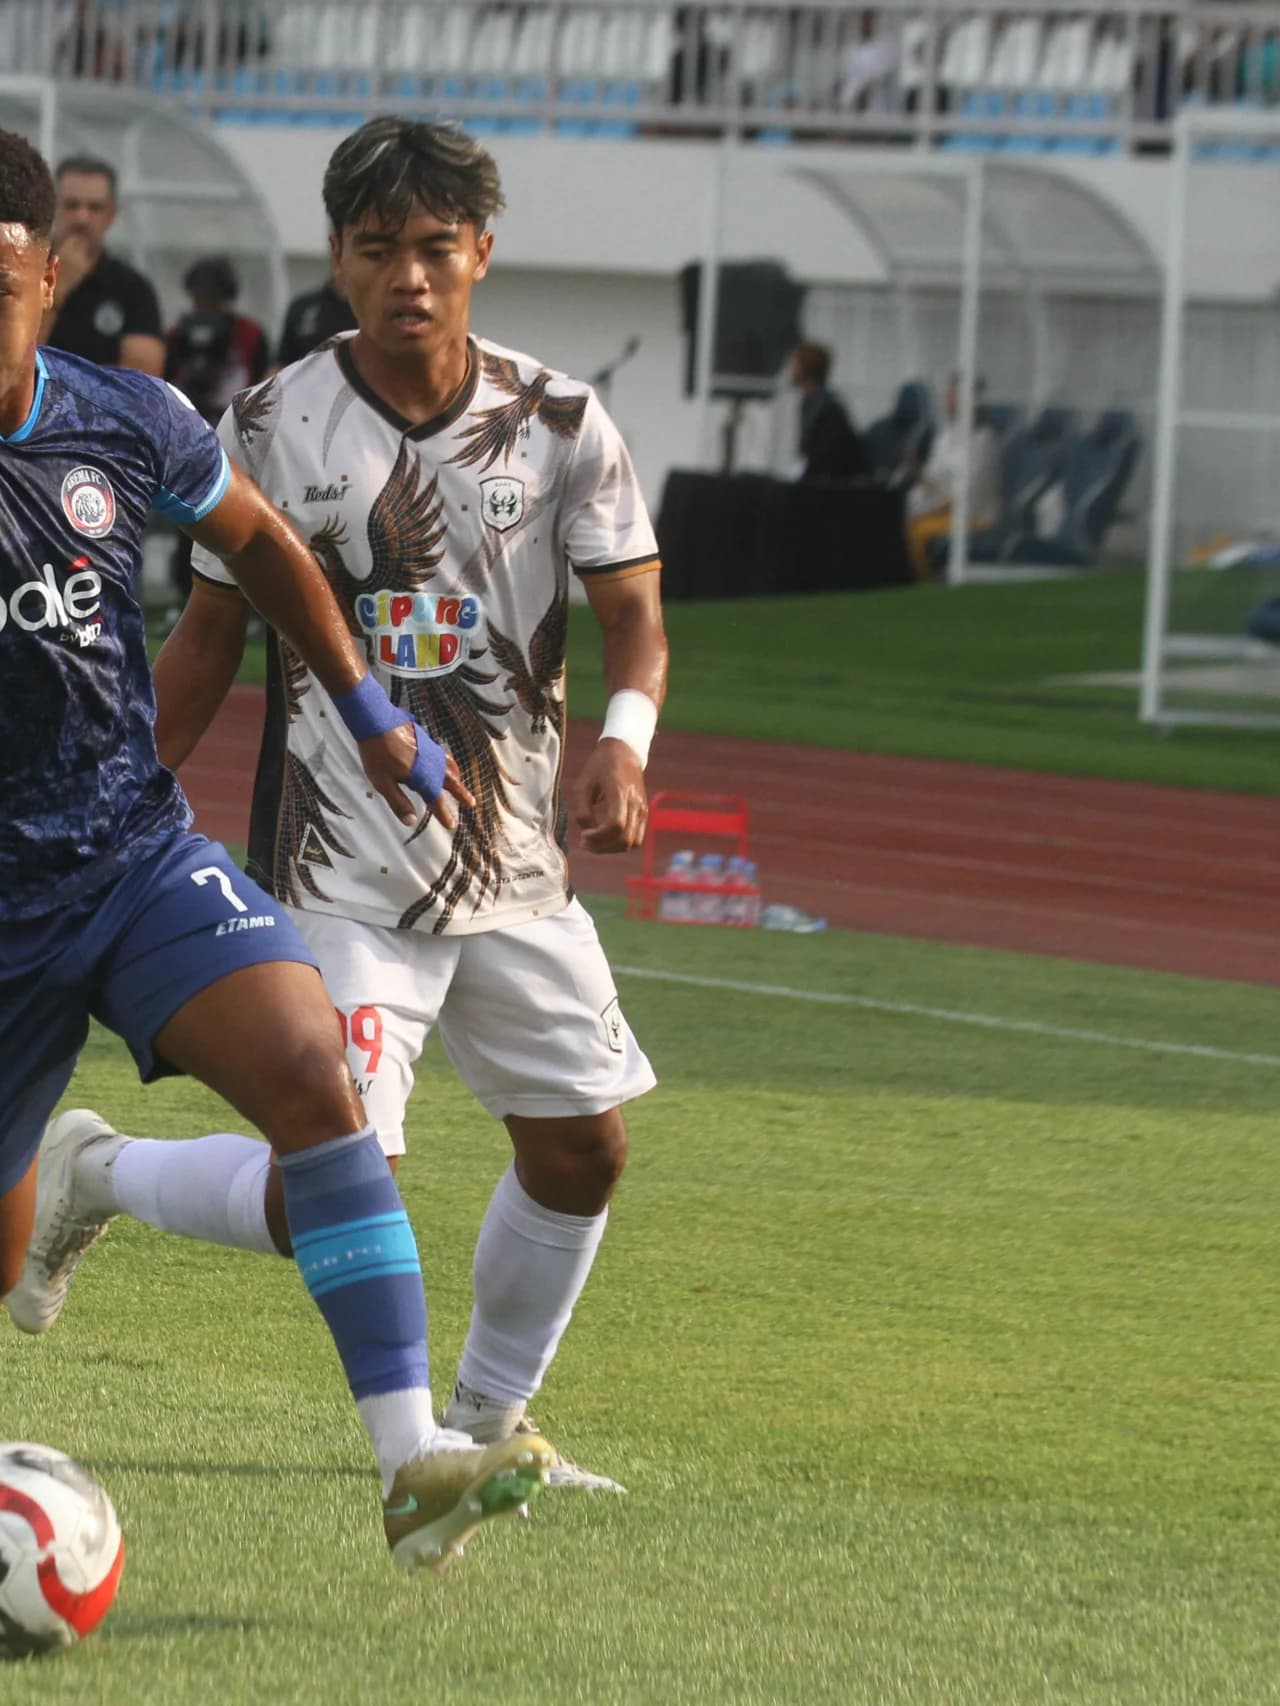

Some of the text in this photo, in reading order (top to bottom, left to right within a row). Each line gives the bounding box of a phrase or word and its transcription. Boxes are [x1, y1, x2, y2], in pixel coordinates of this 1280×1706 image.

[90, 470, 102, 485] FC
[380, 633, 458, 669] LAND
[190, 866, 248, 912] 7
